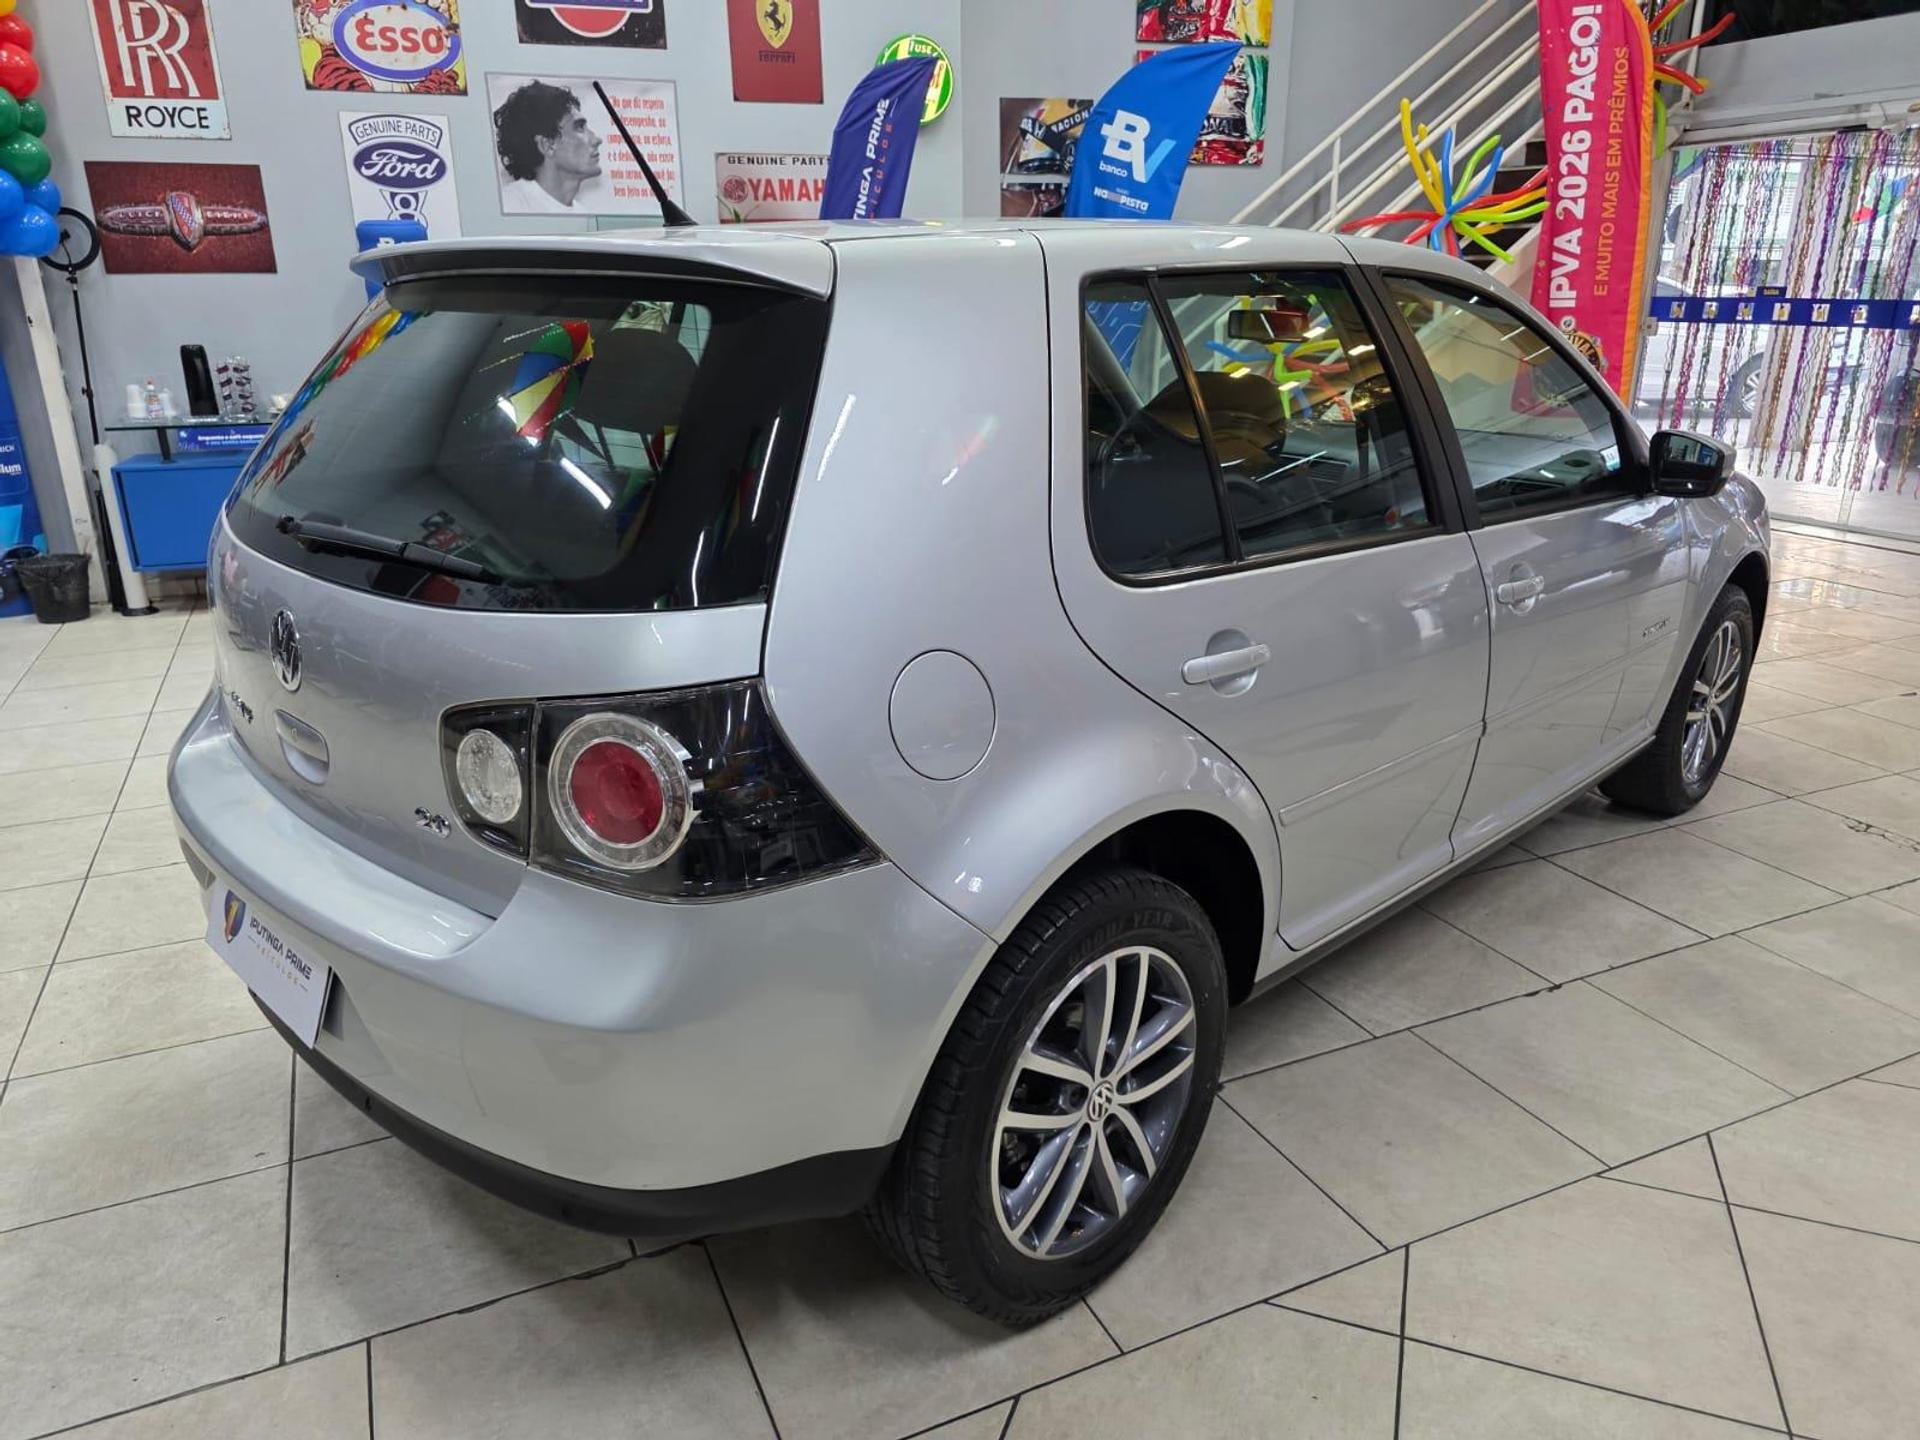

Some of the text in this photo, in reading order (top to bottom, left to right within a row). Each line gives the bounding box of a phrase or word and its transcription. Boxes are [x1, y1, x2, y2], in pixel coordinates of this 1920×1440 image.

[125, 105, 211, 129] ROYCE
[866, 98, 890, 160] PRIME
[1051, 108, 1095, 133] NACION
[355, 120, 438, 143] GENUINE PARTS
[361, 149, 440, 179] Ford
[728, 155, 786, 165] GENUINE
[1549, 4, 1603, 308] IPVA 2026 PAGO!
[1099, 160, 1127, 178] banco
[1594, 47, 1629, 296] E MUITO MAIS EM PRÊMIOS
[748, 178, 826, 202] YAMAH
[250, 916, 313, 981] IPUTINGA PRIME
